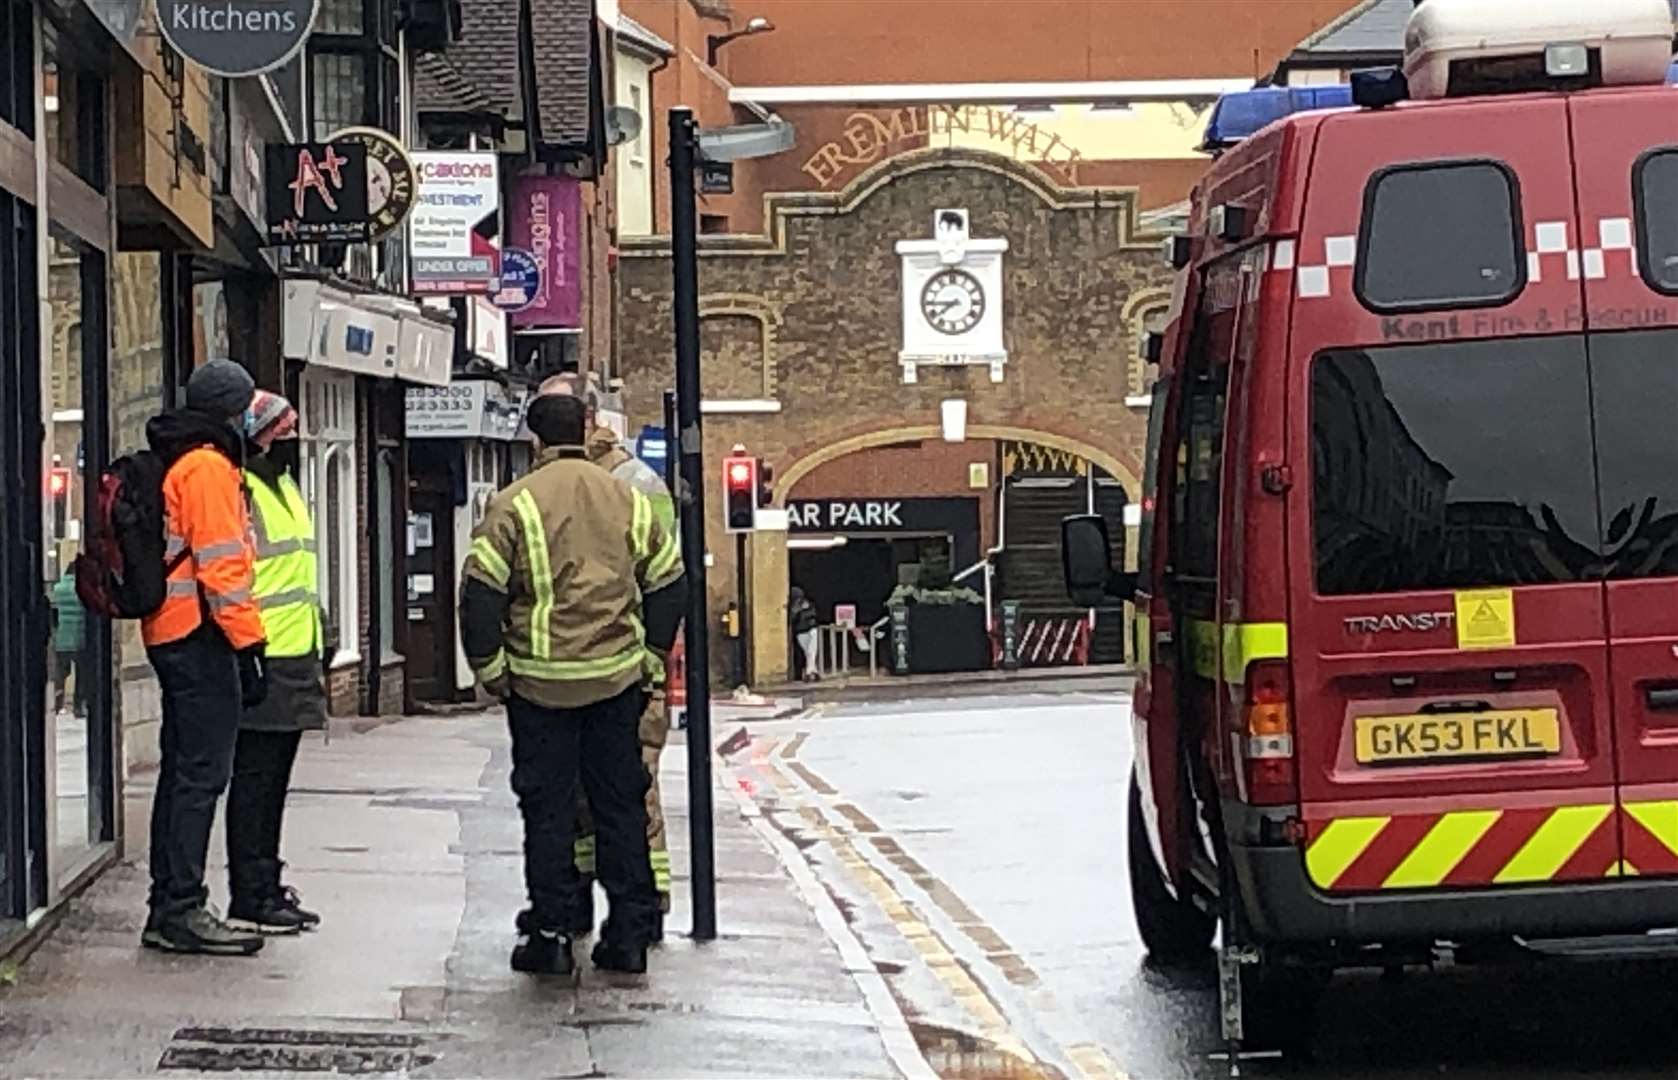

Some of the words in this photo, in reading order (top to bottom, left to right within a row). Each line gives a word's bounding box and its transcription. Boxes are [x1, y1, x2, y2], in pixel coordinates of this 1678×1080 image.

[173, 2, 296, 32] Kitchens
[417, 260, 454, 273] UNDER
[456, 260, 488, 273] OFFER
[1381, 316, 1460, 340] Kent
[1536, 308, 1551, 331] &
[786, 502, 821, 527] AR
[829, 501, 903, 526] PARK
[1343, 611, 1456, 633] TRANSIT
[1371, 720, 1465, 755] GK53
[1473, 717, 1544, 751] FKL
